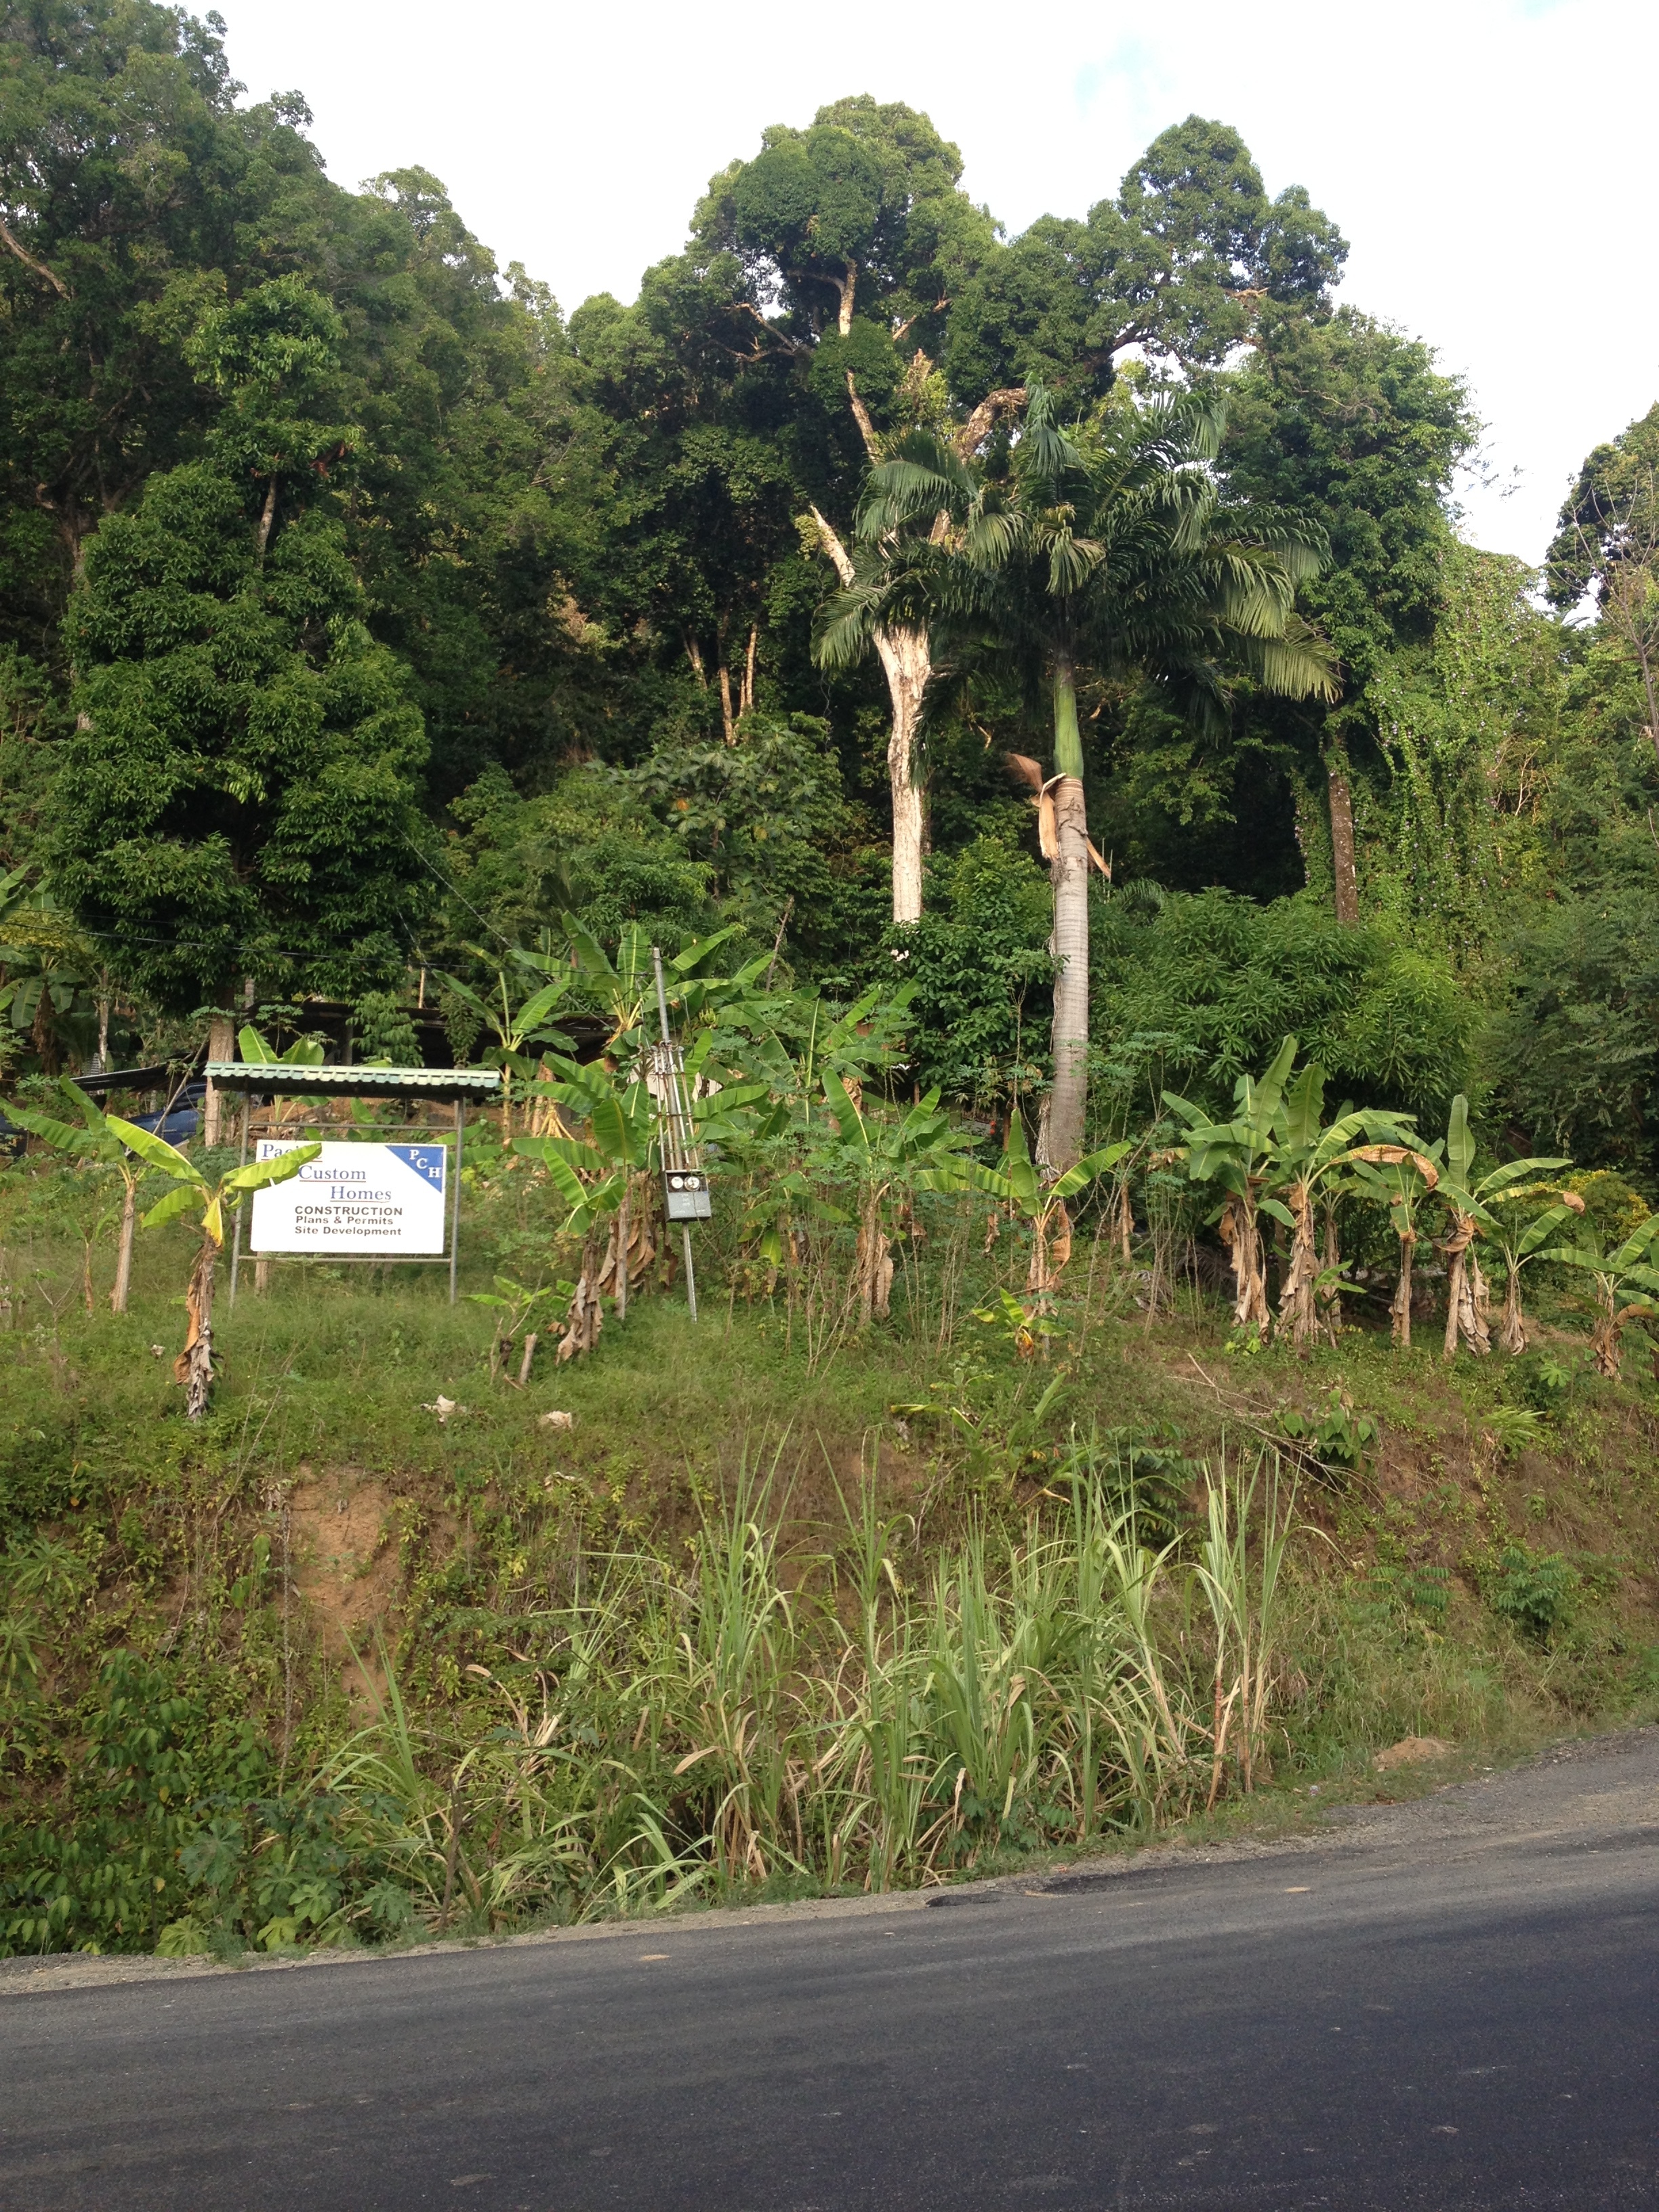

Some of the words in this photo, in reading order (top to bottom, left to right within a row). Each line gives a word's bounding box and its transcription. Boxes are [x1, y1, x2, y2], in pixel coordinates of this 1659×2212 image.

[298, 1165, 366, 1180] Custom
[331, 1186, 392, 1200] Homes
[295, 1206, 403, 1216] CONSTRUCTION
[296, 1216, 329, 1224] Plans
[348, 1216, 394, 1225] Permits
[295, 1226, 319, 1234] Site
[323, 1227, 402, 1236] Development
